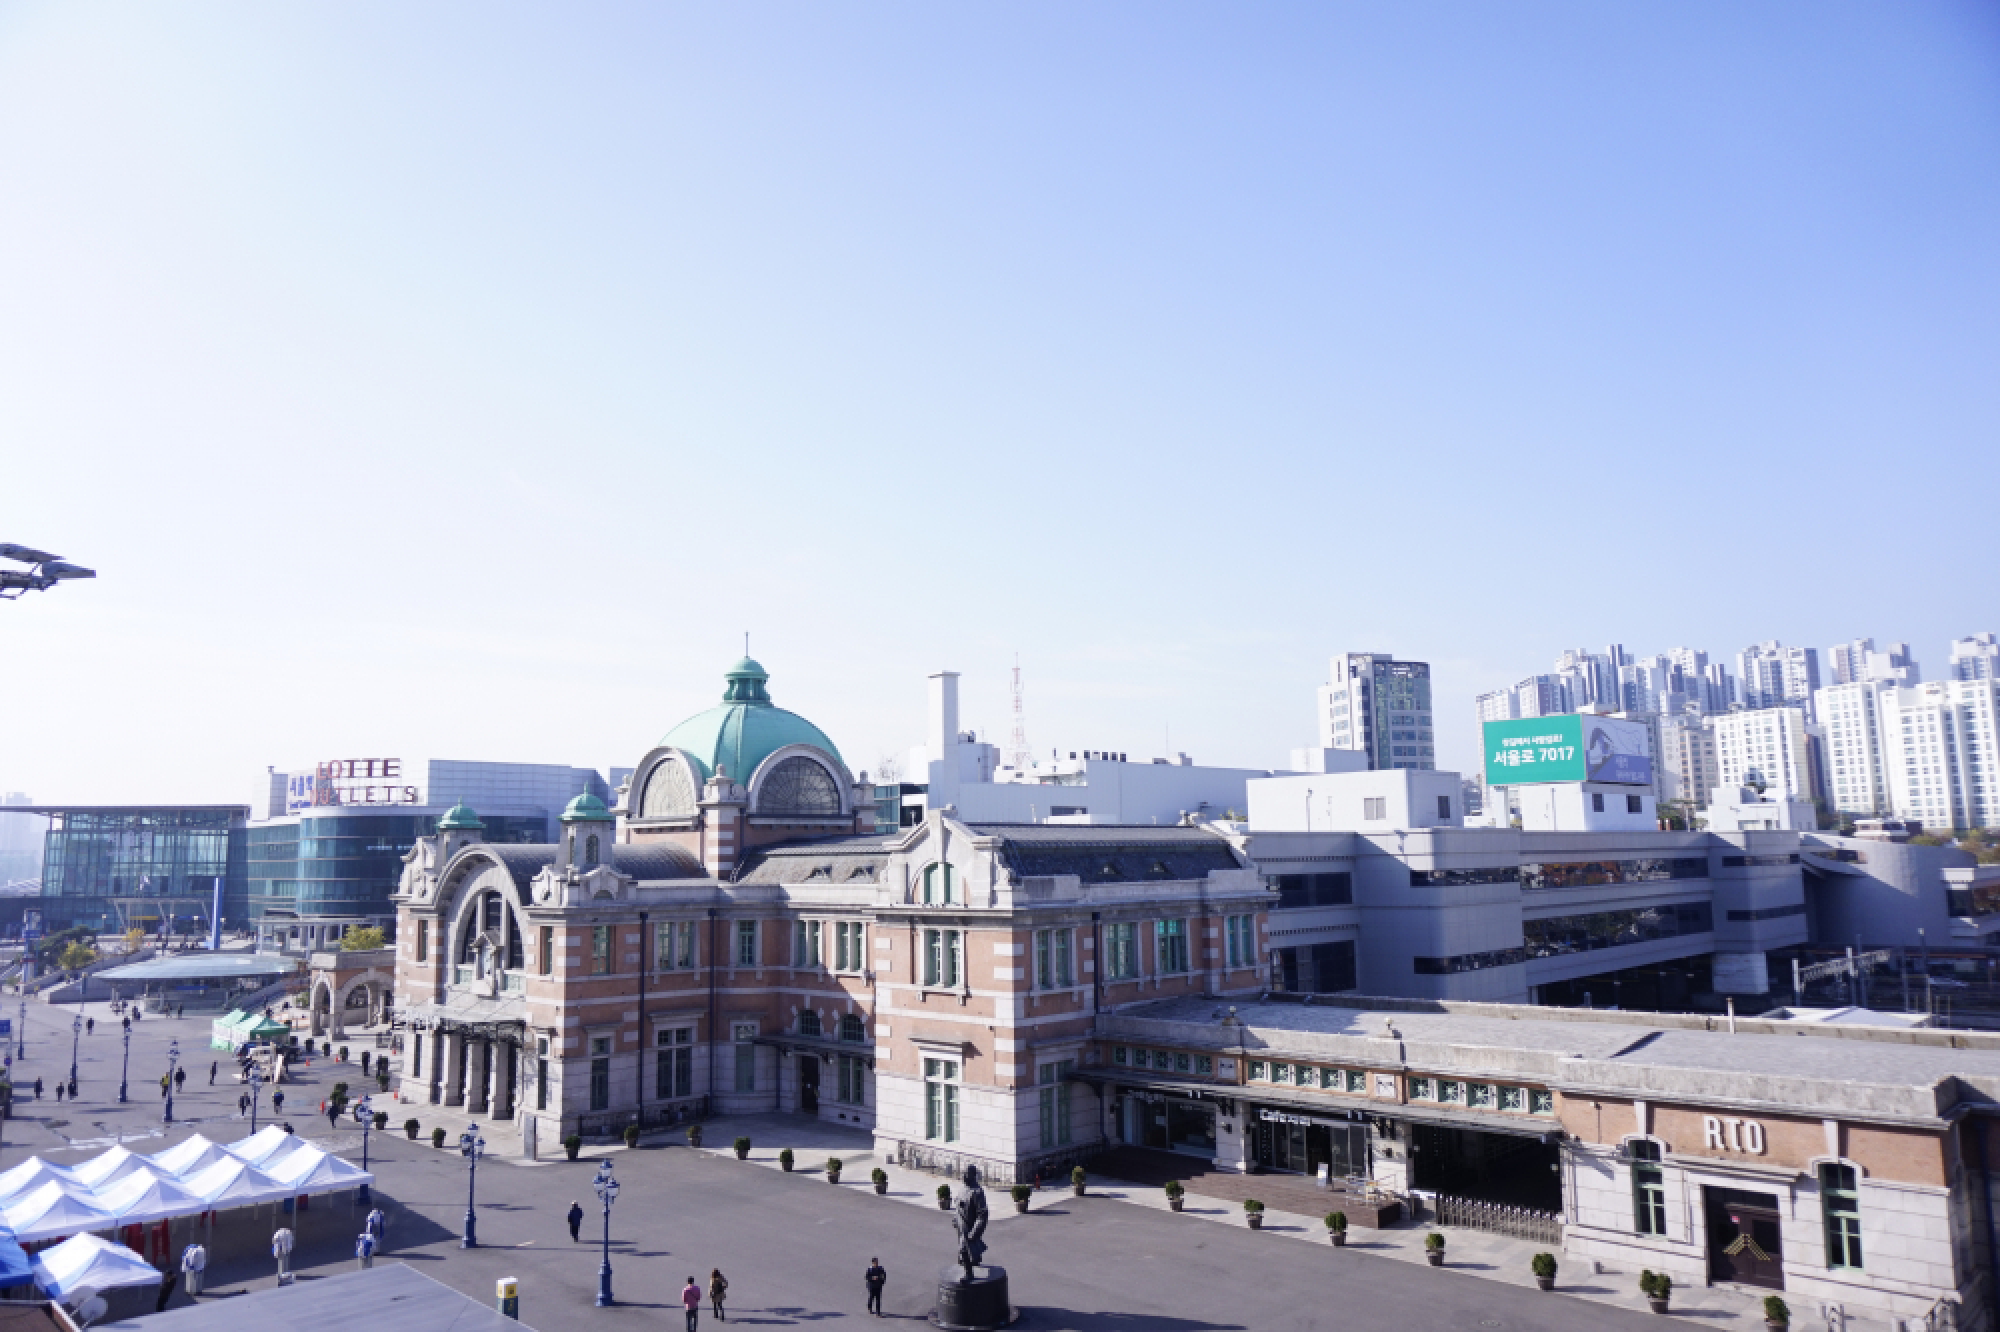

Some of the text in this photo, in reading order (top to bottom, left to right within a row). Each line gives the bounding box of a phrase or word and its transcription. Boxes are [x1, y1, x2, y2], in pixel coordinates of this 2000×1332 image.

[1493, 746, 1574, 767] 서울로 7017
[318, 758, 400, 780] LOTTE
[310, 786, 416, 806] OUTLETS
[1704, 1115, 1765, 1153] RTO
